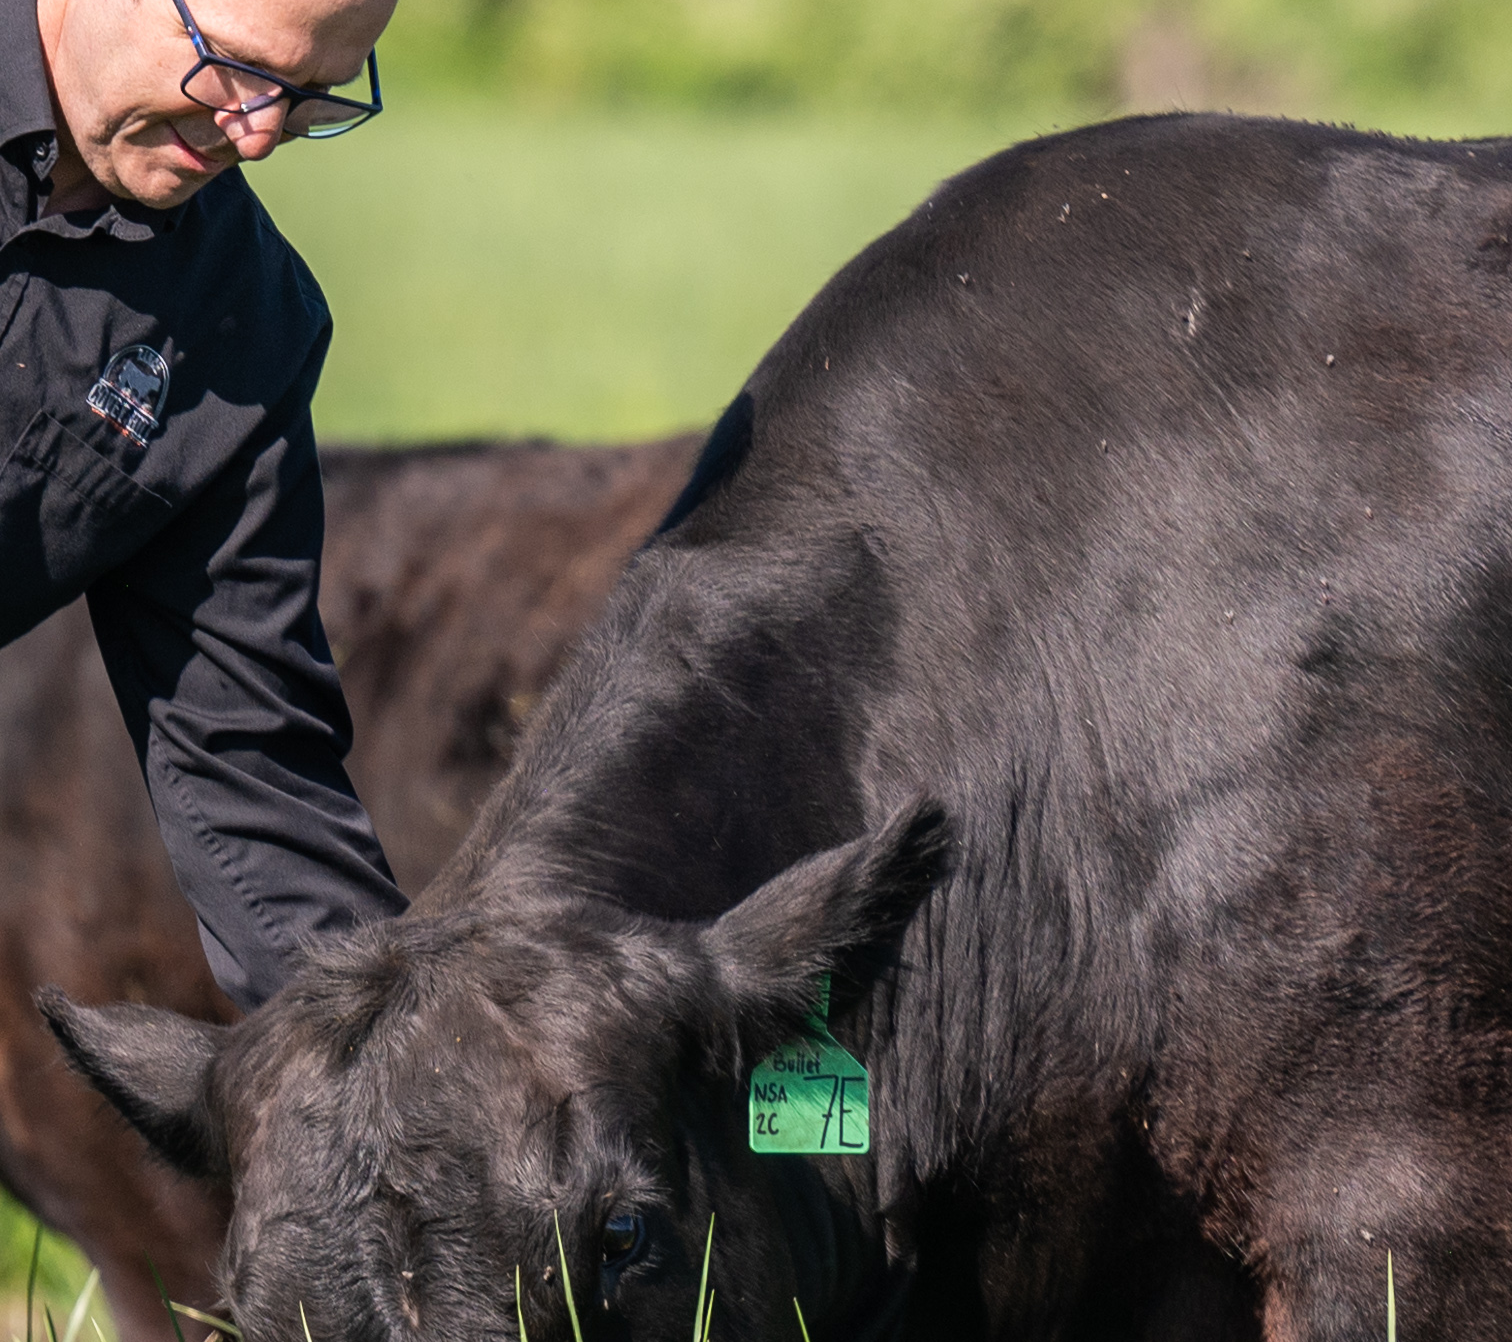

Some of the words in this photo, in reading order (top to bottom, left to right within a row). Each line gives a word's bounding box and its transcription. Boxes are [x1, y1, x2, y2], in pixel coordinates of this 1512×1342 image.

[773, 1051, 821, 1074] Bullet
[754, 1082, 788, 1104] NSA
[803, 1074, 865, 1149] 7E
[755, 1112, 779, 1135] 2C
